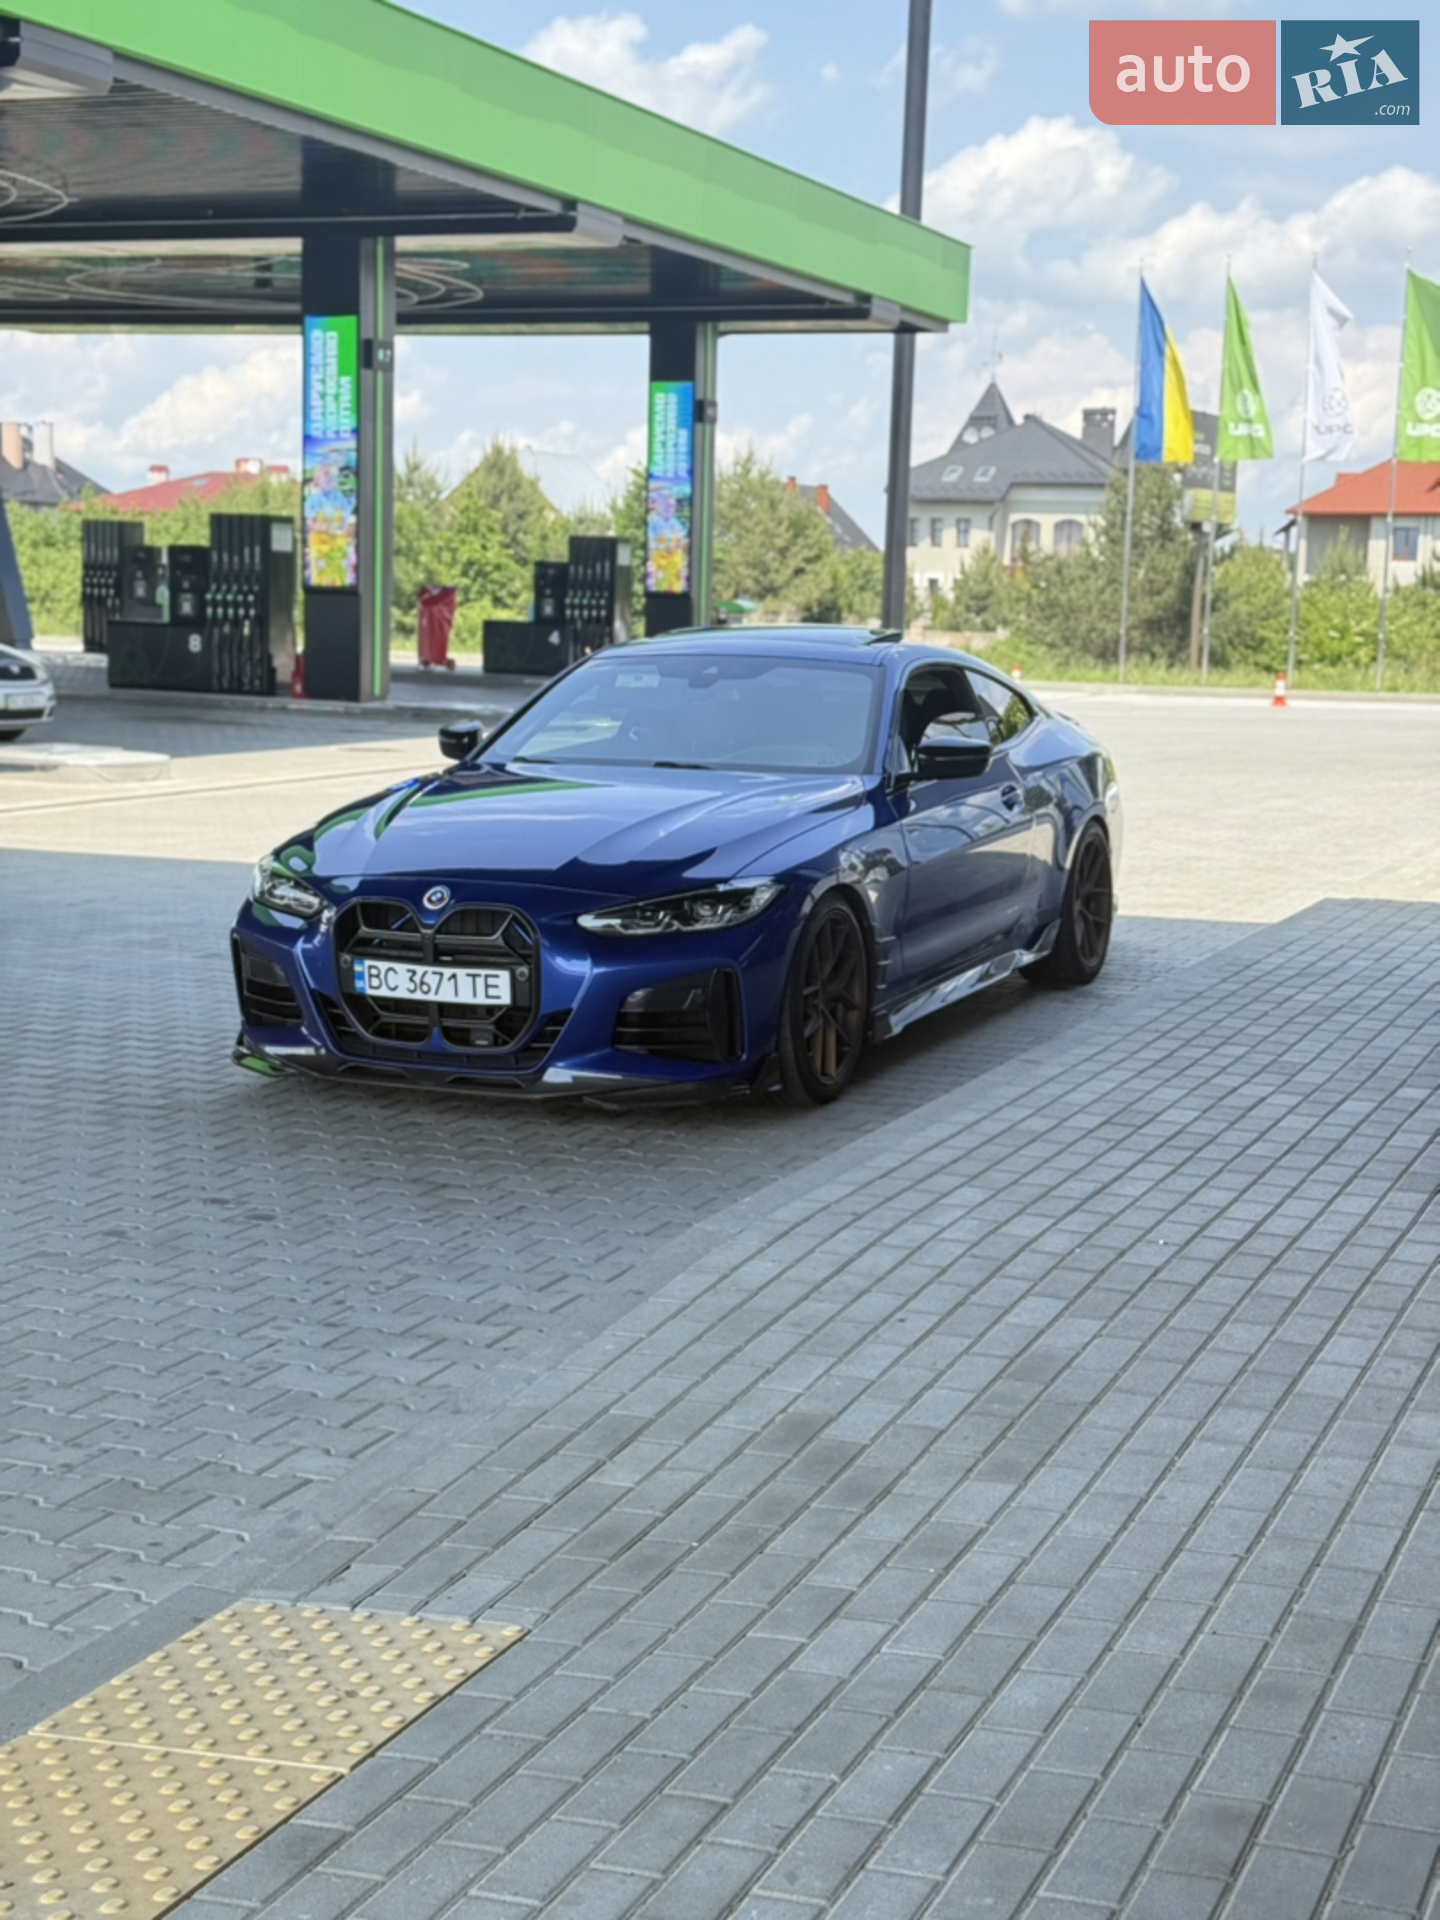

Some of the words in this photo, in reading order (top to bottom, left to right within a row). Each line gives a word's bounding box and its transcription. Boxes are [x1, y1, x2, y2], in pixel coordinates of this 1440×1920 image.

[188, 633, 202, 653] 8
[367, 964, 399, 992] BC
[406, 968, 459, 997] 3671
[466, 973, 502, 1000] TE
